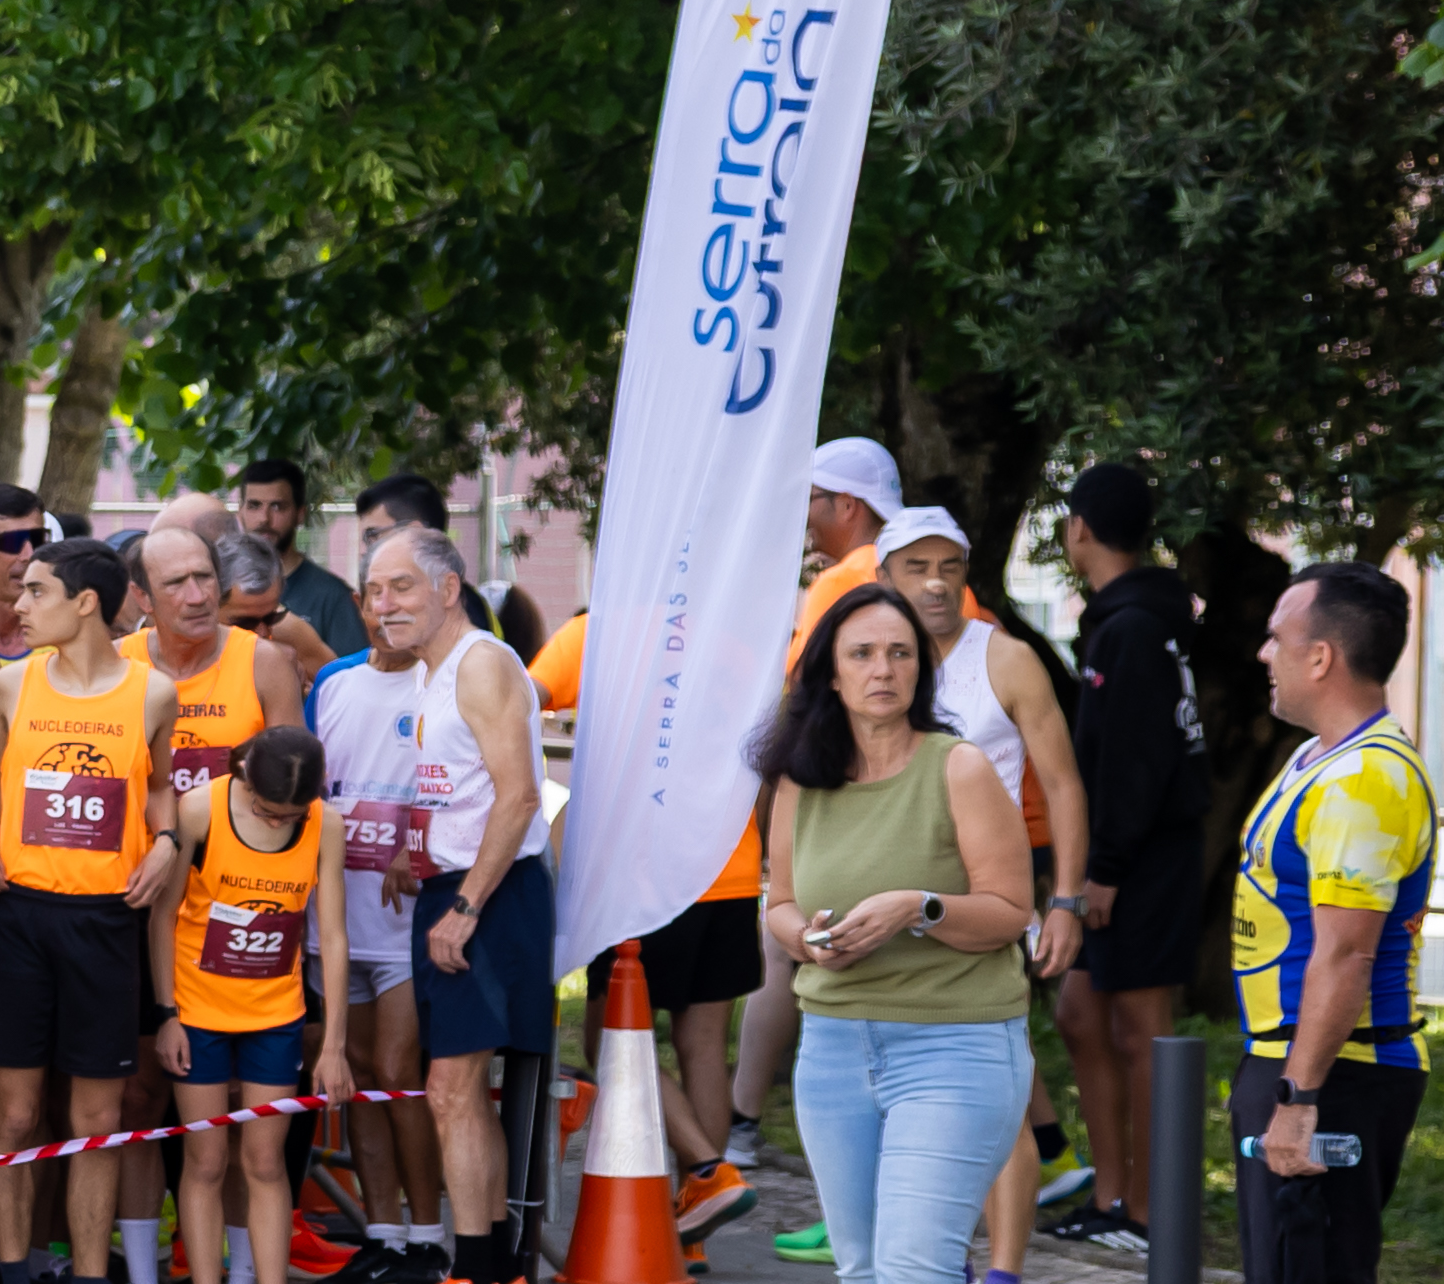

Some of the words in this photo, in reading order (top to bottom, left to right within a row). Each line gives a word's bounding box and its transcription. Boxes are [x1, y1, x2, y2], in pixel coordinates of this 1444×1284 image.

[693, 70, 777, 353] serra
[666, 590, 689, 653] DAS
[28, 719, 125, 737] NUCLEOEIRAS
[657, 672, 682, 769] SERRA
[168, 766, 211, 792] 64
[44, 793, 105, 821] 316
[652, 788, 667, 806] A
[220, 874, 308, 894] NUCLEOEIRAS
[226, 928, 284, 953] 322
